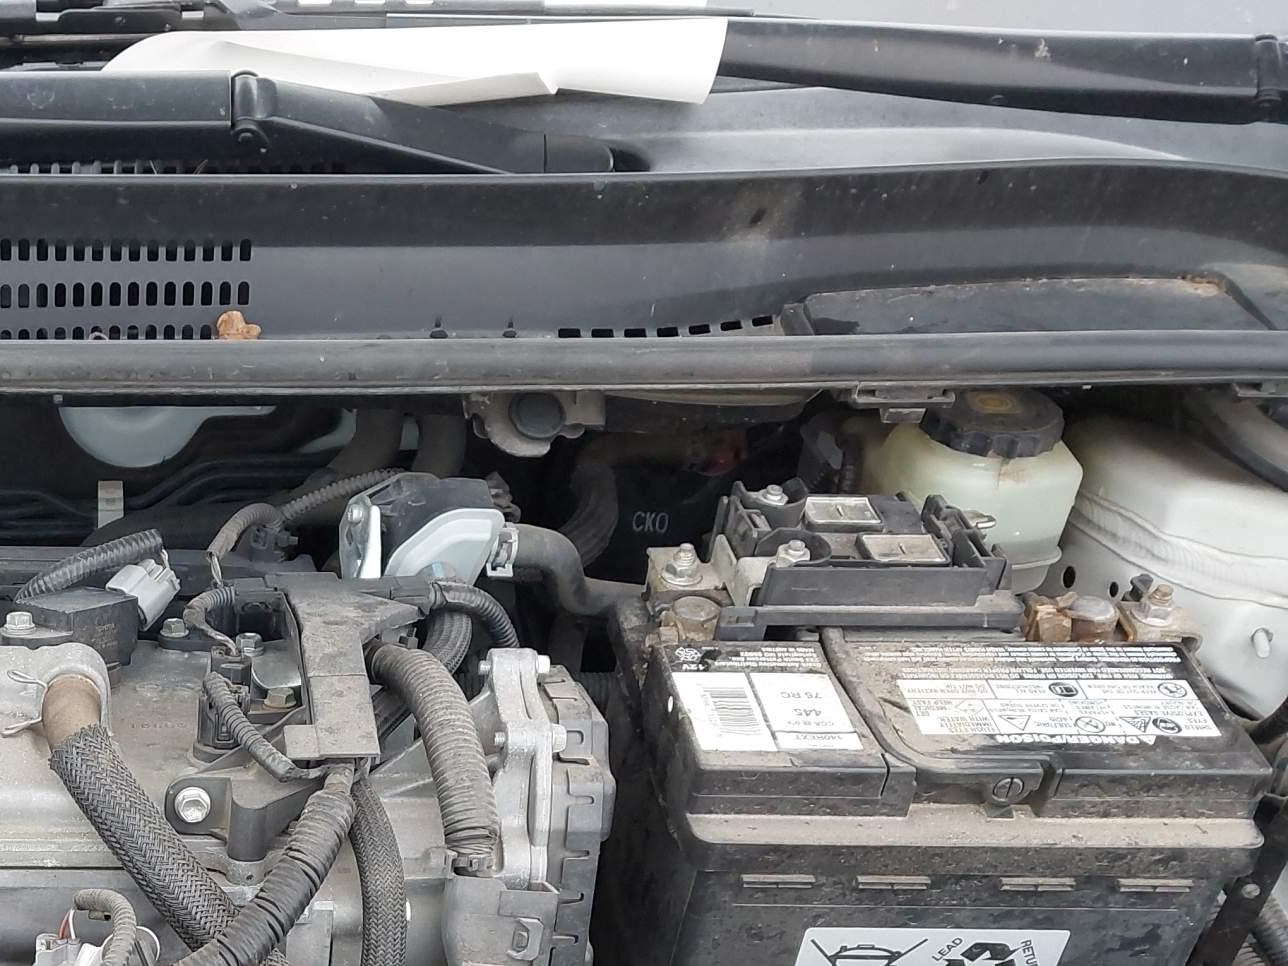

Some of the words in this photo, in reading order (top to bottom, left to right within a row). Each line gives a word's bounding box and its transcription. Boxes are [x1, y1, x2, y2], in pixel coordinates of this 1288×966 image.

[681, 663, 706, 671] 12V
[779, 691, 802, 699] RC
[792, 708, 822, 717] 445
[996, 734, 1140, 744] DANGER/POISON
[931, 937, 964, 962] LEAD
